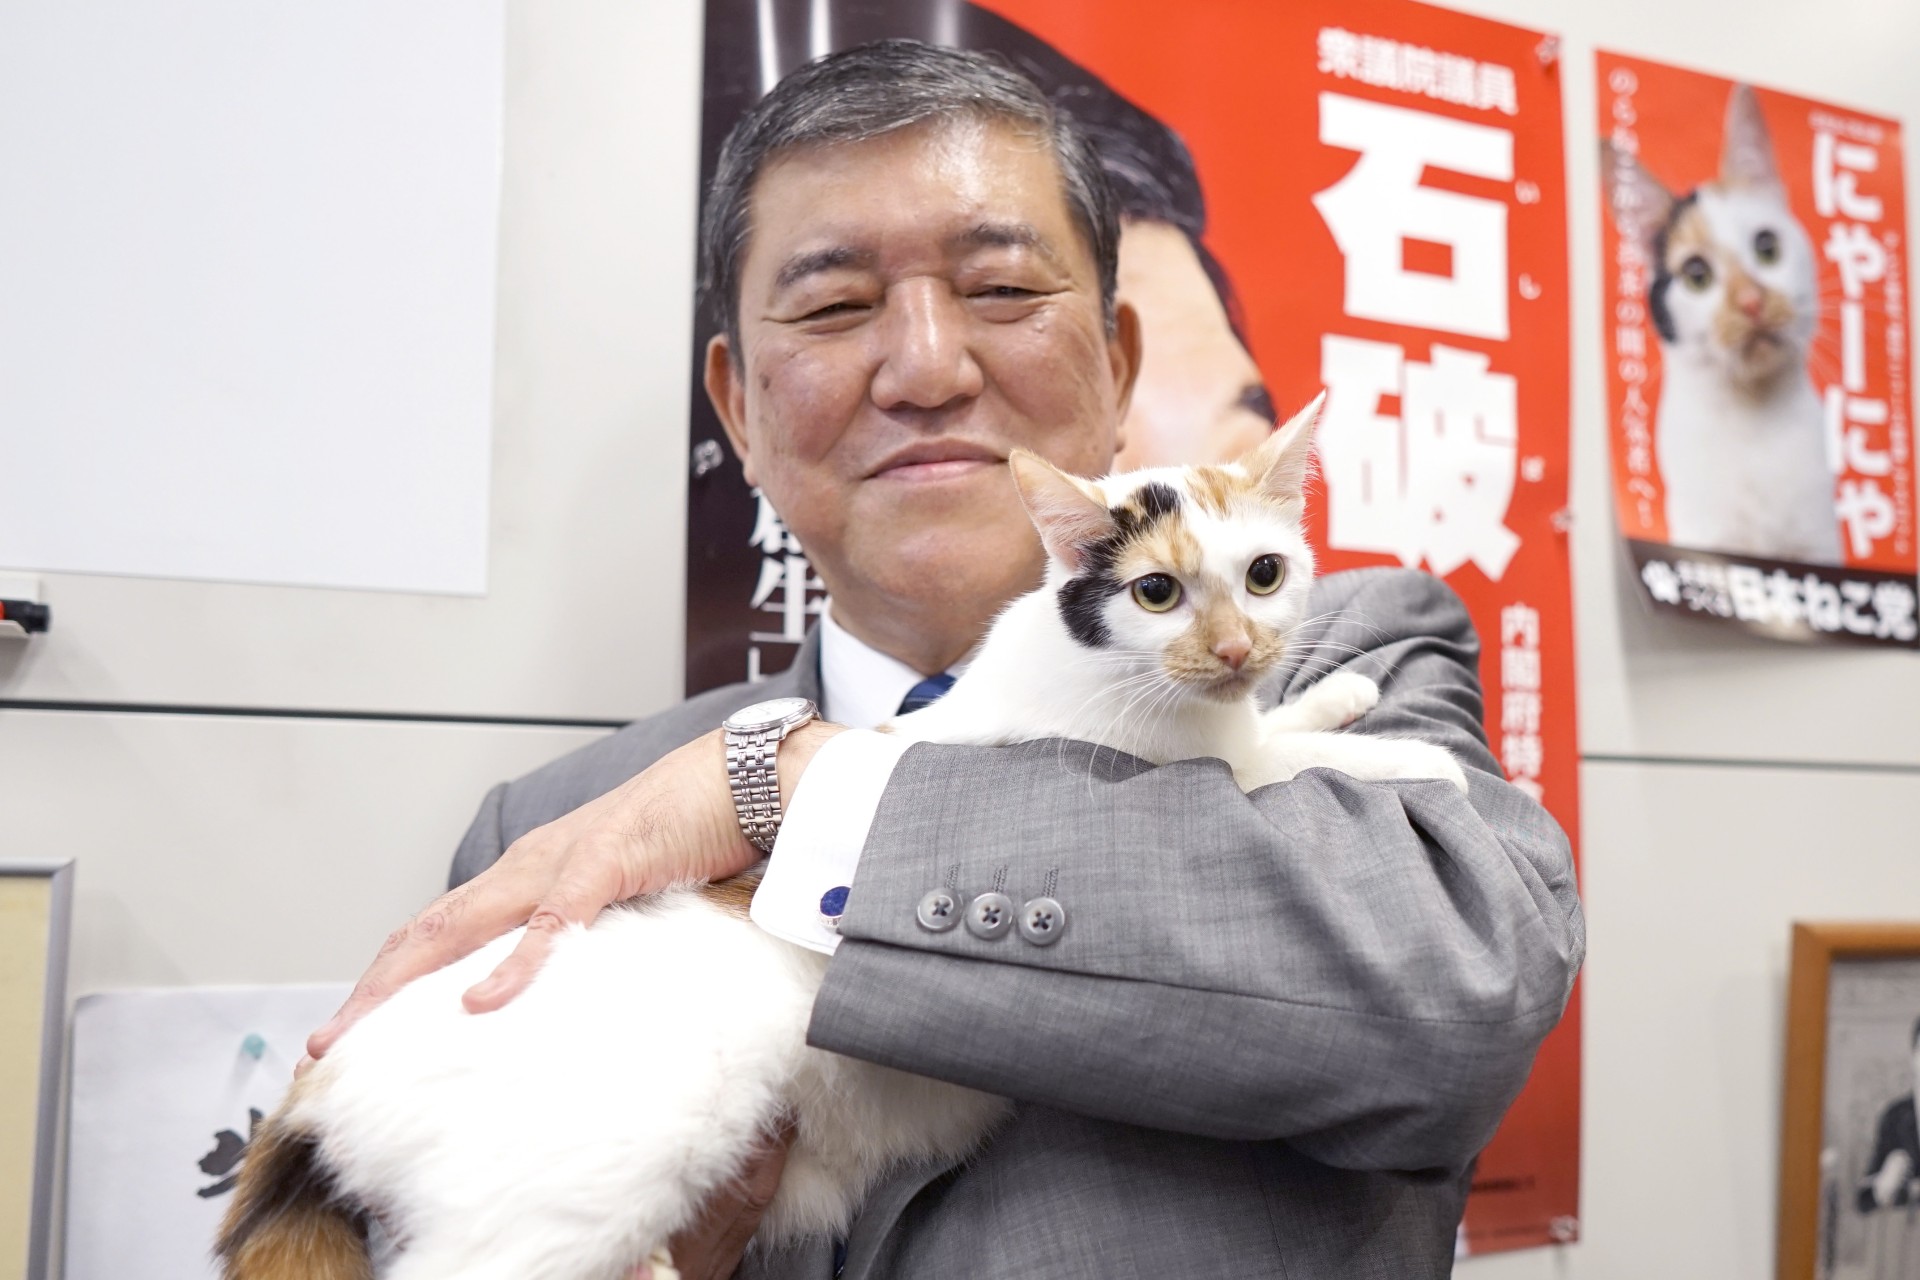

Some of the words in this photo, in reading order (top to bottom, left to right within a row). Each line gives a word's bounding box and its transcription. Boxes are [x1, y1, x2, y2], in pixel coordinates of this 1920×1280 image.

[1318, 27, 1518, 115] 衆議院議員
[1312, 91, 1521, 582] 石破
[1727, 564, 1917, 641] 日本ねこ党
